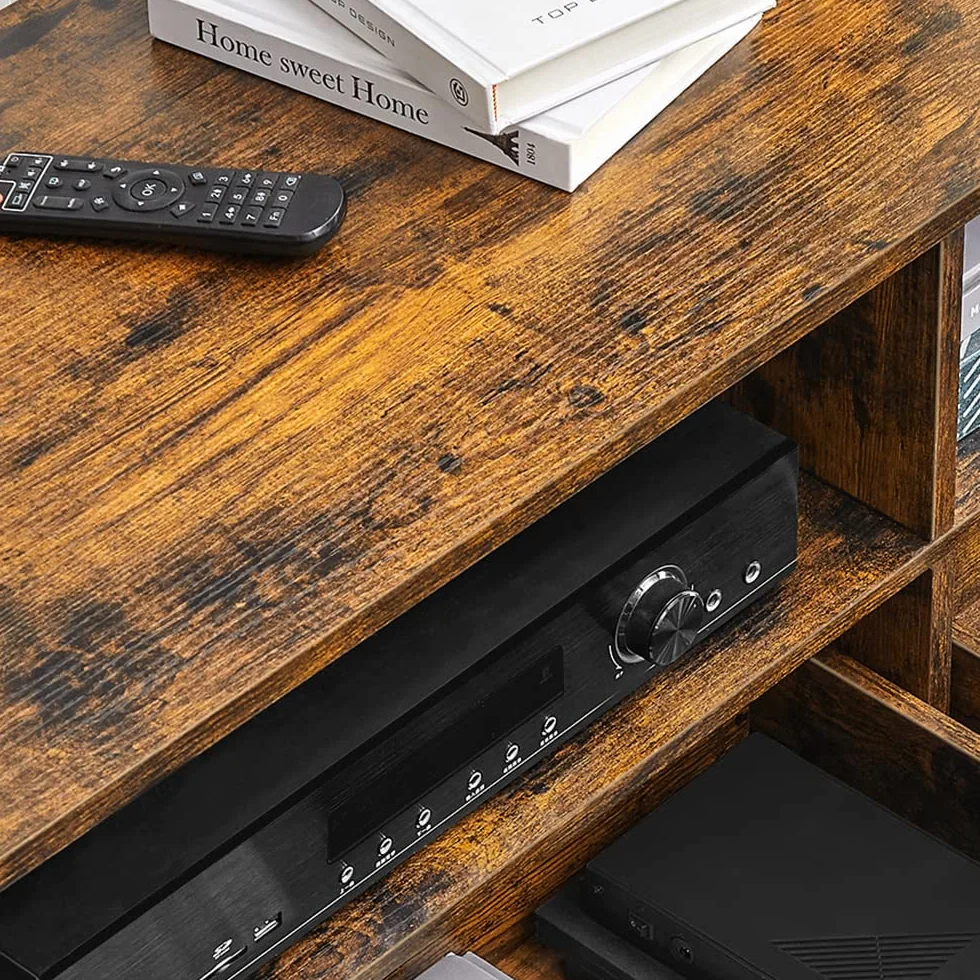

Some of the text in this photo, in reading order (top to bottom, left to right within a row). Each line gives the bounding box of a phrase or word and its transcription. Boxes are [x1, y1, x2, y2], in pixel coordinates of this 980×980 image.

[349, 7, 395, 47] DESIGN
[531, 1, 579, 24] TOP
[195, 18, 429, 125] Home sweet Home
[141, 183, 158, 197] OK
